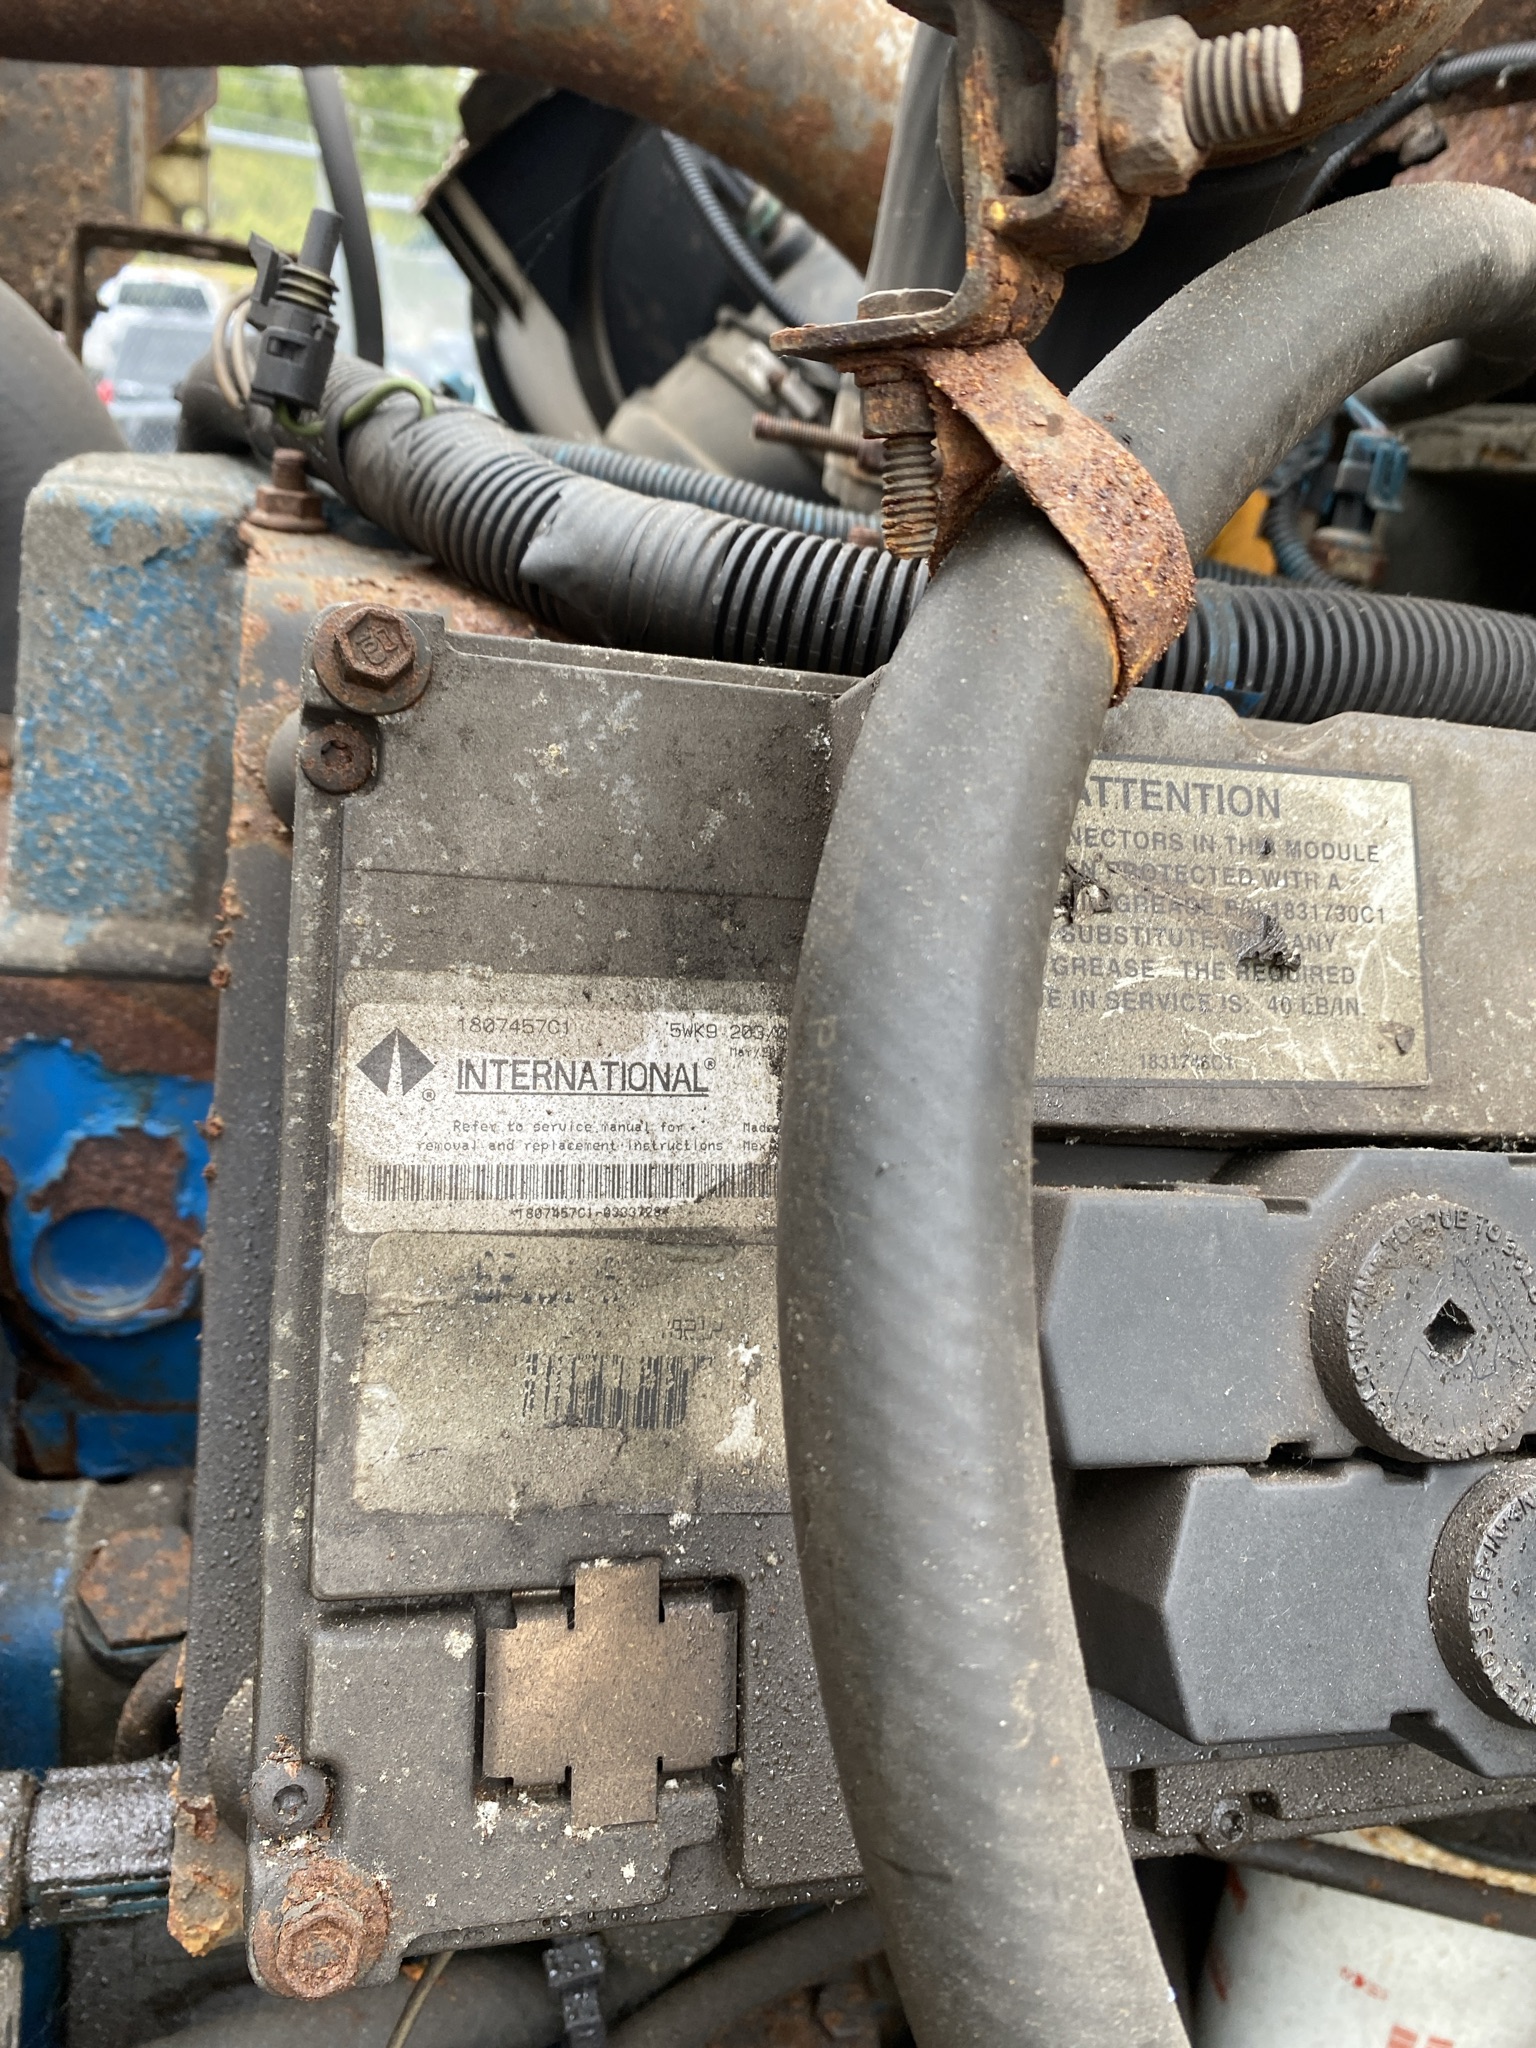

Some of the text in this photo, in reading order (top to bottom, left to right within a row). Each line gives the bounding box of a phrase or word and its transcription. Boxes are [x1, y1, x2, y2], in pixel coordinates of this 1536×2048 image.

[1193, 836, 1216, 855] IN
[1285, 840, 1380, 863] MODULE
[1262, 869, 1319, 890] WITH
[1328, 873, 1342, 891] A
[1292, 933, 1339, 953] ANY
[1180, 959, 1227, 981] THE
[1236, 961, 1356, 986] REQUIRED
[1072, 989, 1097, 1009] IN
[1104, 990, 1214, 1014] SERVICE
[1266, 994, 1293, 1017] 40
[457, 1017, 570, 1036] 1807457C1
[669, 1022, 718, 1039] 5WK9
[453, 1120, 497, 1134] Refer
[506, 1121, 524, 1133] to
[533, 1121, 595, 1134] service
[601, 1120, 650, 1133] manual
[660, 1120, 685, 1133] for
[417, 1140, 477, 1153] removal
[484, 1140, 517, 1152] and
[523, 1140, 618, 1155] replacement
[626, 1139, 724, 1153] instructions
